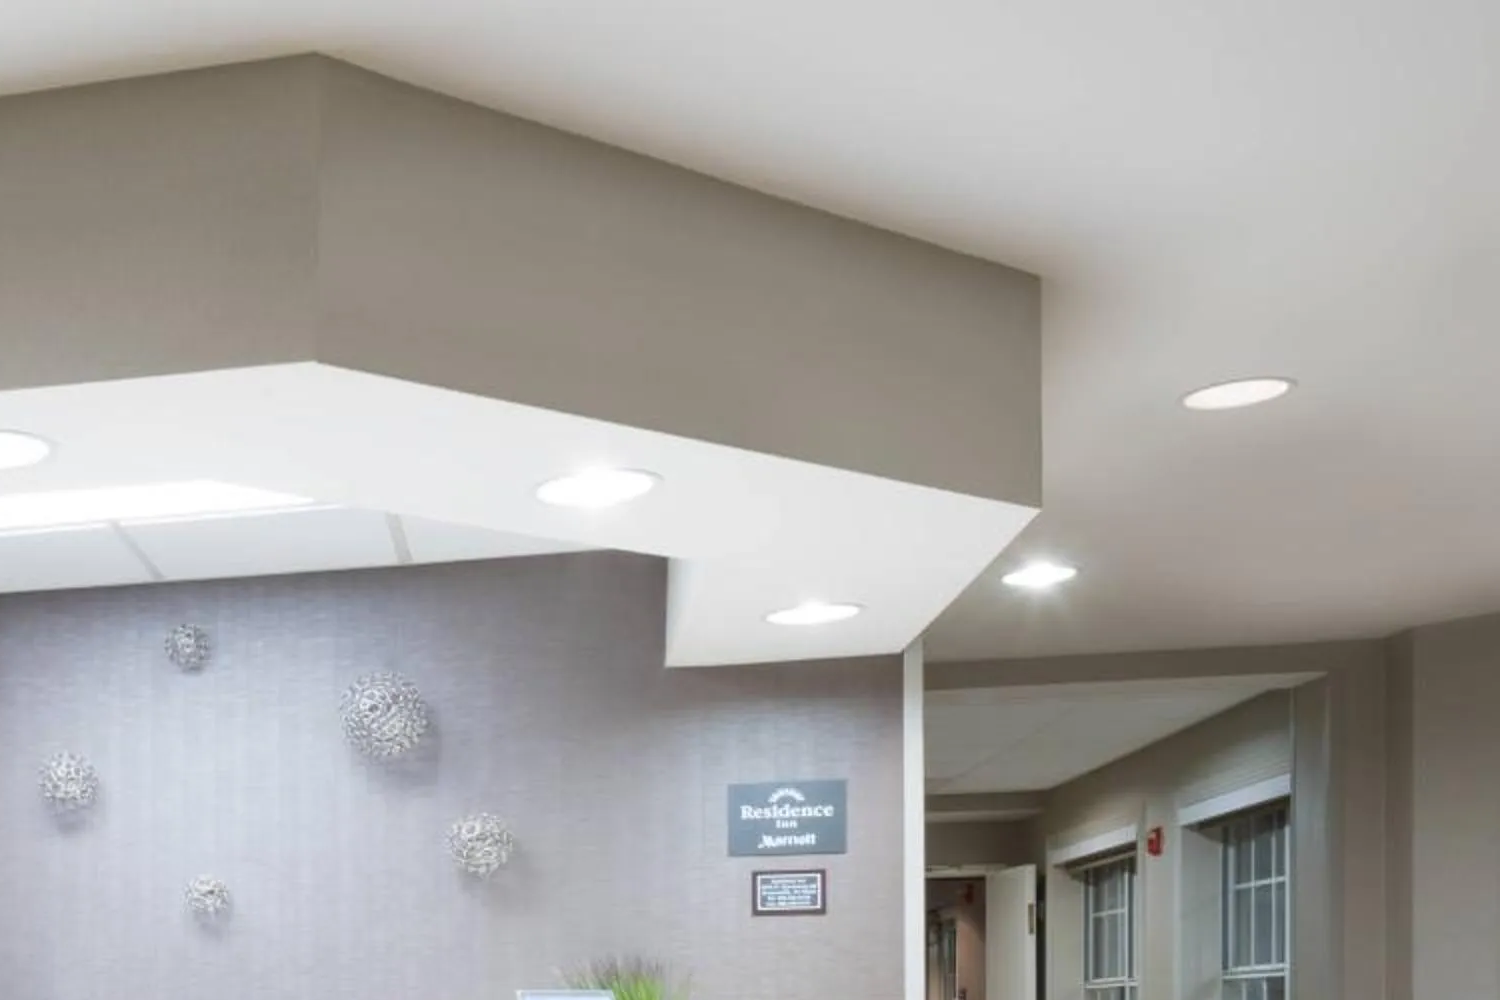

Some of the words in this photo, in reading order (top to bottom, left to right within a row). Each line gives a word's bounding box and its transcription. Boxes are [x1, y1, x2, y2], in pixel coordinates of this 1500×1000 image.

[740, 803, 834, 819] Residence
[775, 819, 798, 829] Inn
[757, 832, 817, 849] Marriott
